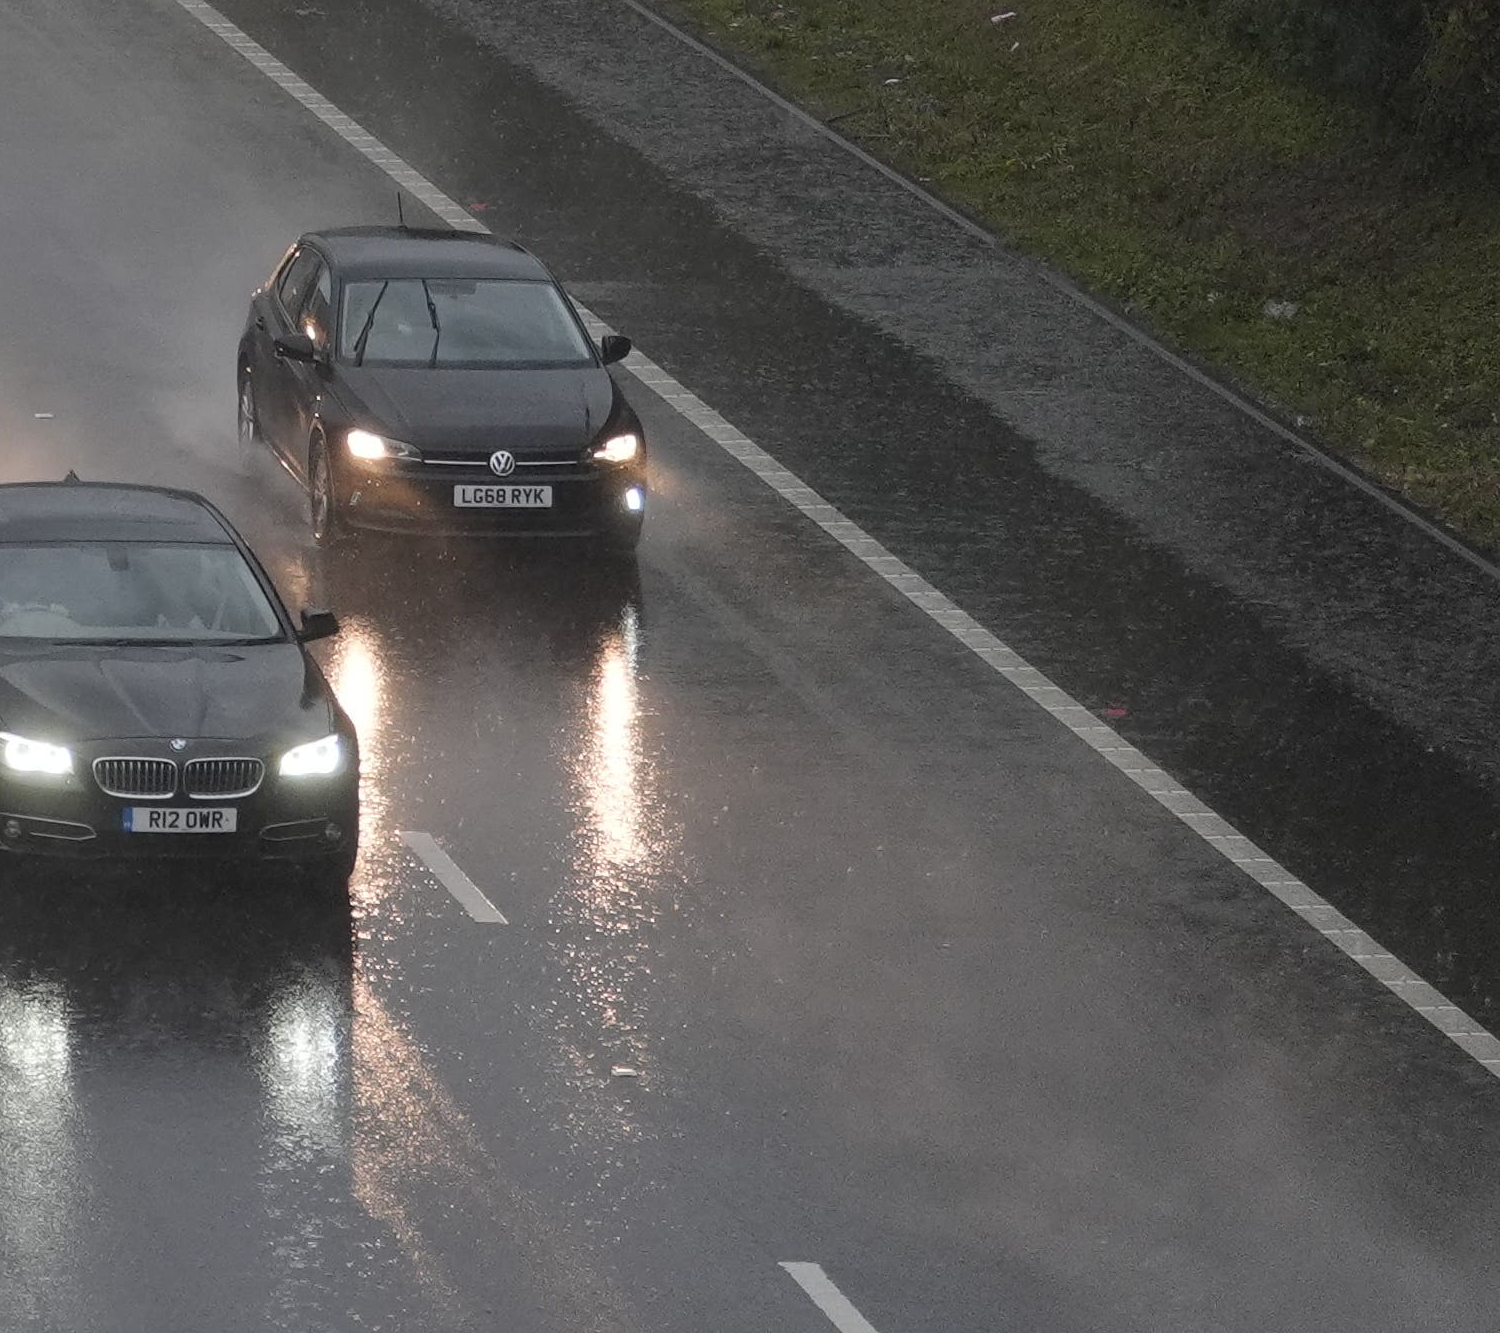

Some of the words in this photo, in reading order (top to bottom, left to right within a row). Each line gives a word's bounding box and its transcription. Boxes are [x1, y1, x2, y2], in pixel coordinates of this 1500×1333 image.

[462, 488, 506, 504] LG68
[511, 488, 545, 504] RYK
[149, 810, 180, 829] R12
[186, 810, 223, 829] OWR
